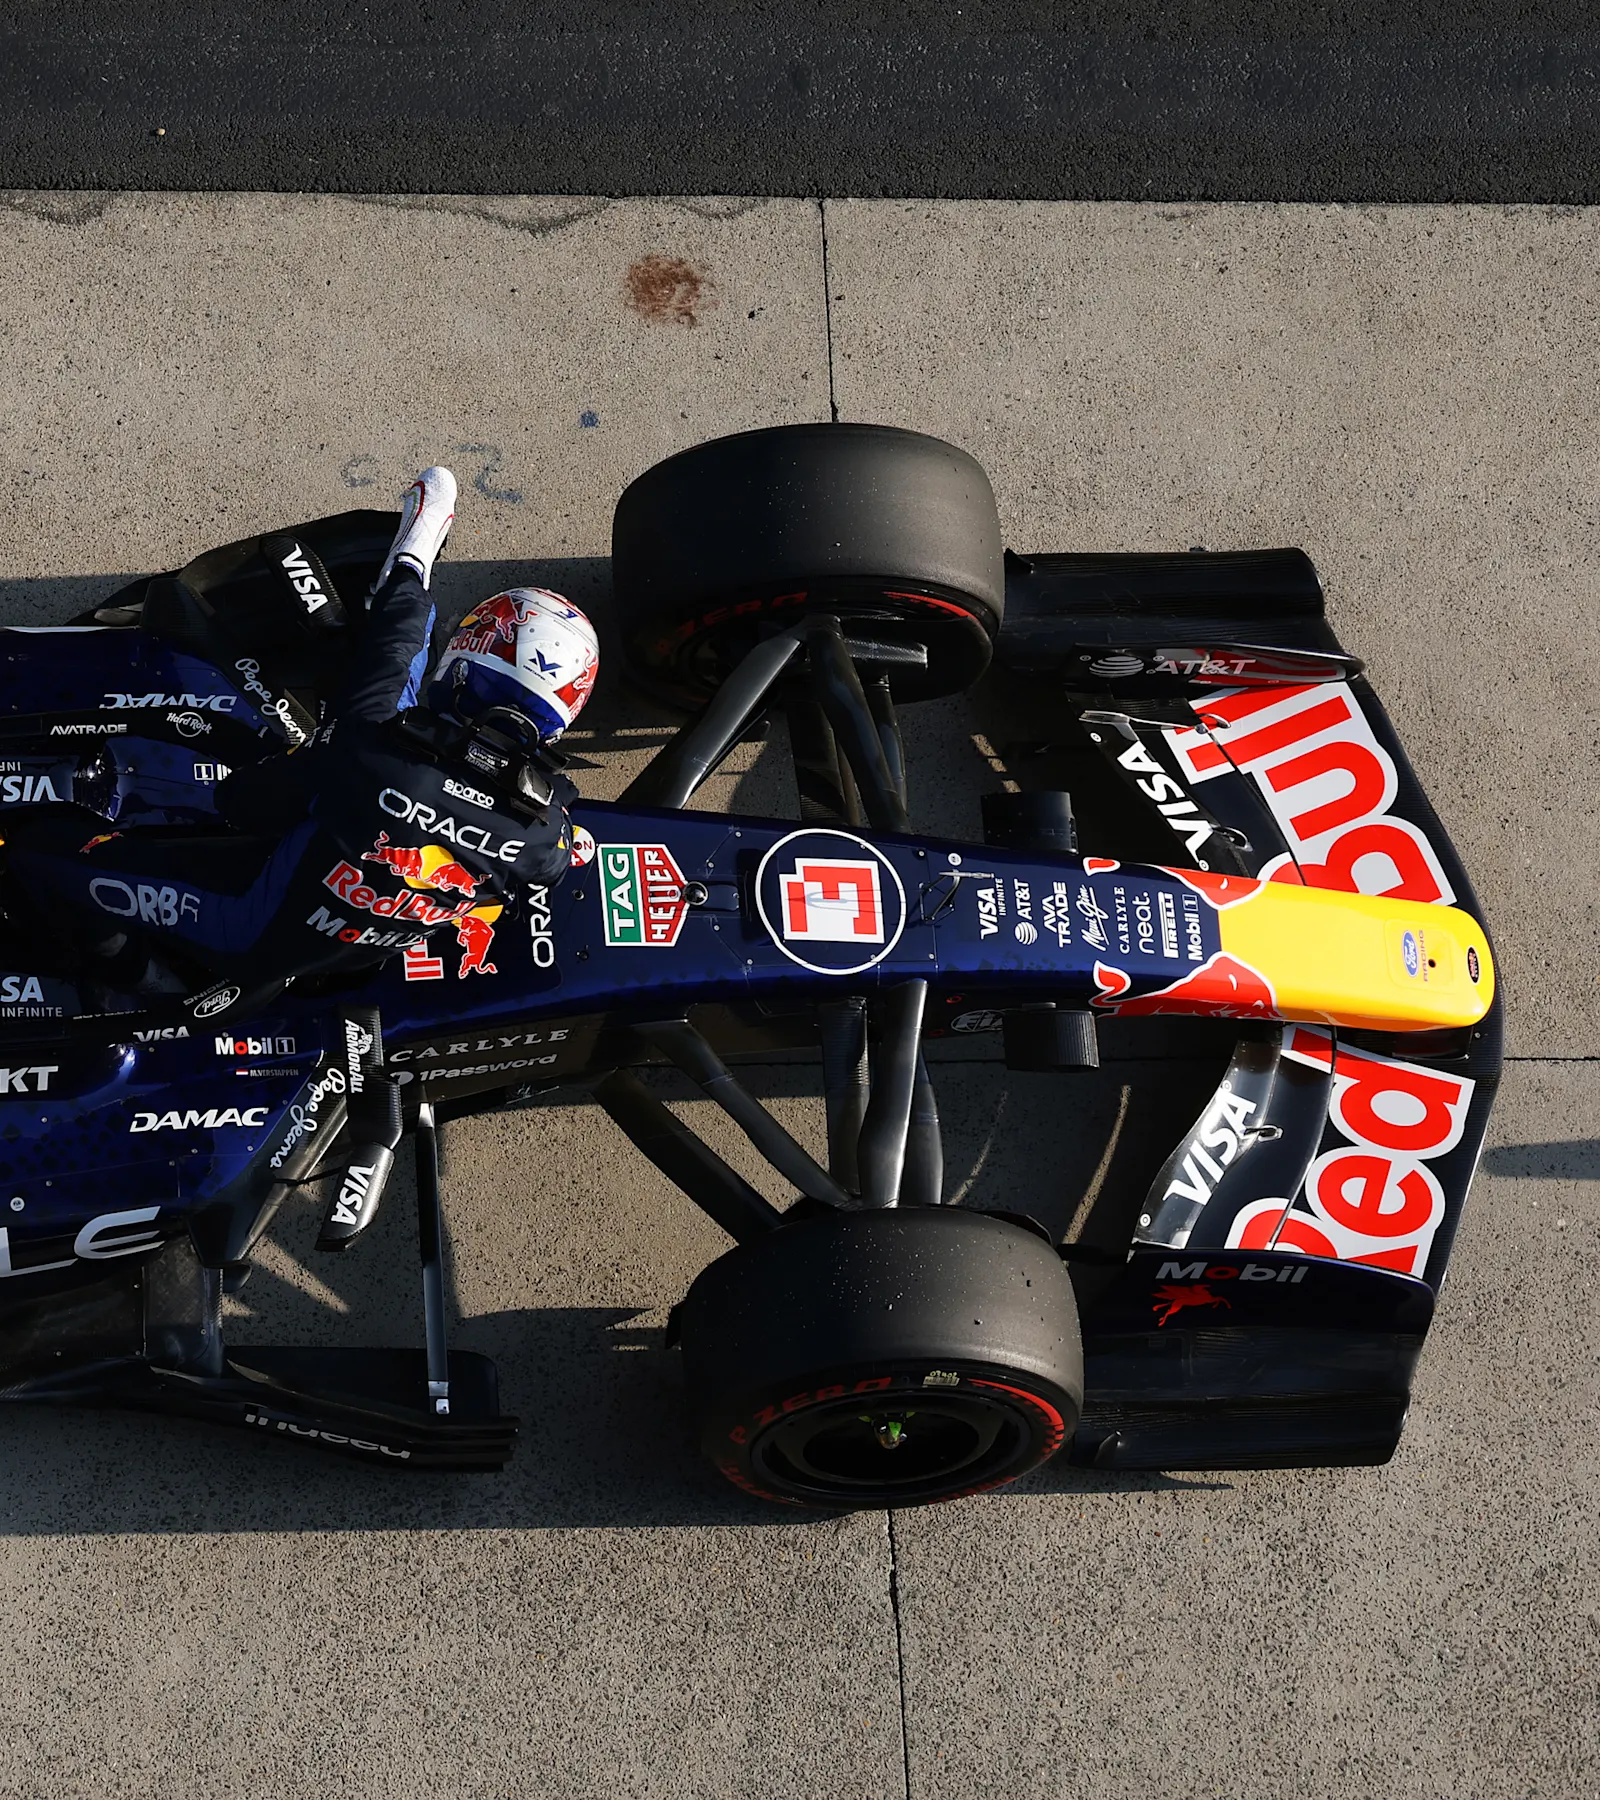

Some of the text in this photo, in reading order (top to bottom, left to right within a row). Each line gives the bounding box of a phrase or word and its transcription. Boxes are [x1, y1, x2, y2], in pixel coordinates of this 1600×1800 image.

[281, 543, 329, 614] VISA
[235, 658, 272, 702] Pepe
[1154, 659, 1257, 675] AT&T
[99, 694, 237, 712] DAMAC
[166, 711, 213, 735] Hard Rock
[50, 723, 128, 736] AVATRADE
[443, 778, 495, 808] sparco
[1117, 739, 1213, 863] VISA
[1161, 683, 1458, 906] Bull
[378, 788, 526, 863] ORACLE
[322, 860, 479, 926] Red Bull
[607, 852, 636, 939] TAG
[646, 850, 683, 940] HEUER
[976, 887, 999, 940] VISA
[995, 878, 1007, 916] INFINITE
[1014, 878, 1033, 920] AT&T
[1041, 895, 1057, 933] AVA
[1053, 881, 1072, 948] TRADE
[306, 905, 404, 947] Mobil
[529, 884, 554, 968] ORA
[1081, 917, 1106, 951] Maui
[1114, 886, 1130, 954] CARLYLE
[1132, 891, 1155, 954] neat.
[1158, 891, 1179, 958] PIRELLI
[1184, 913, 1204, 961] Mobil
[1, 1006, 63, 1019] INFINITE
[132, 1025, 191, 1043] VISA
[215, 1037, 273, 1056] Mobil
[389, 1028, 570, 1063] CARLYLE
[419, 1053, 558, 1082] 1Password
[129, 1106, 270, 1133] DAMAC
[269, 1067, 346, 1168] Pepe Jeans
[1162, 1090, 1259, 1206] VISA
[330, 1163, 377, 1226] VISA
[1155, 1261, 1309, 1284] Mobil
[727, 1376, 893, 1447] P ZERO
